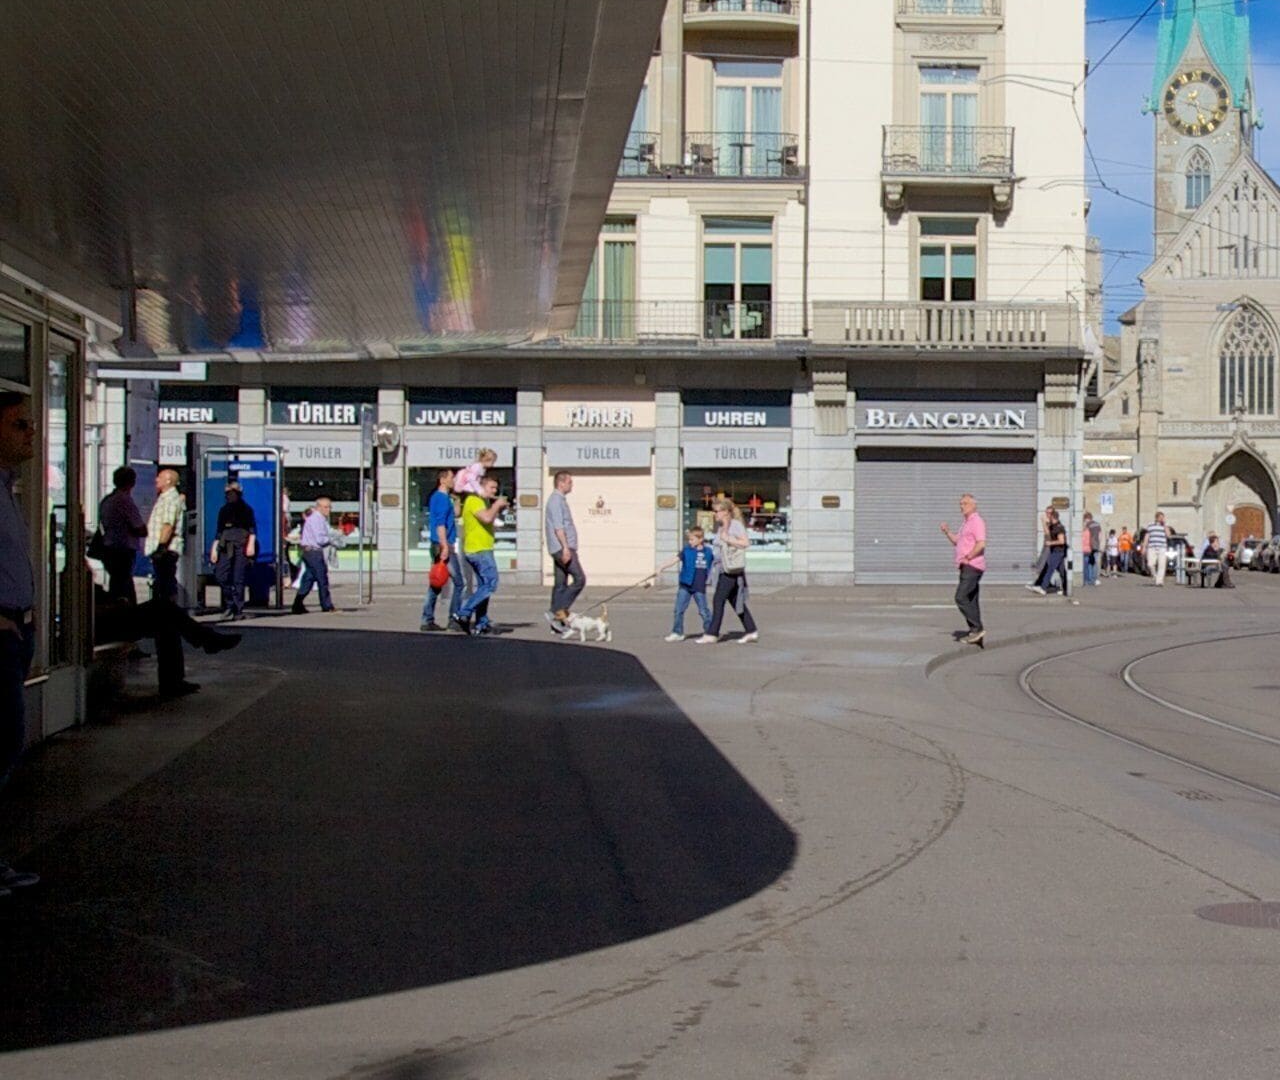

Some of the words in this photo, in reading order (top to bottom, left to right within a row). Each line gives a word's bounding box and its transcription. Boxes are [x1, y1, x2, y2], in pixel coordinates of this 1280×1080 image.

[287, 401, 356, 424] TÜRLER
[415, 409, 506, 425] JUWELEN
[566, 404, 633, 427] TÜRLER
[704, 410, 767, 426] UHREN
[865, 408, 1028, 430] BLANCPAIN
[298, 445, 342, 459] TÜRLER
[576, 445, 621, 460] TÜRLER
[713, 445, 758, 460] TÜRLER
